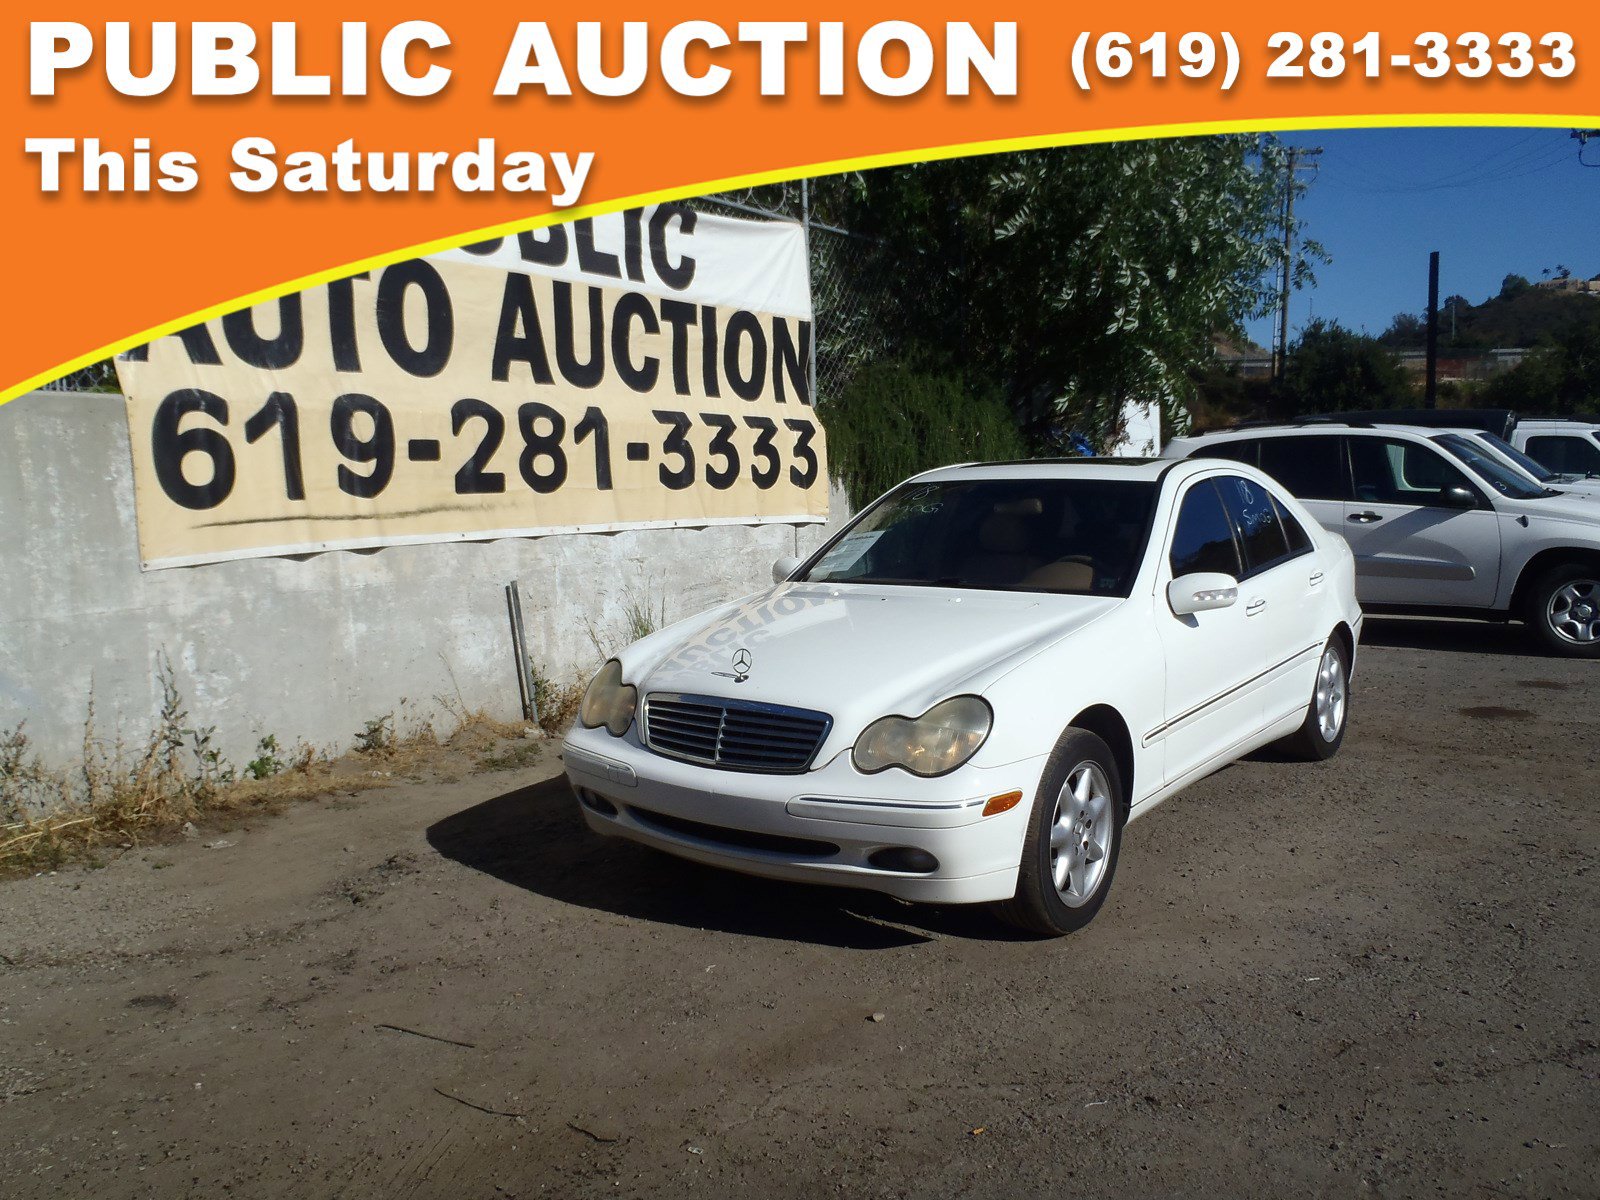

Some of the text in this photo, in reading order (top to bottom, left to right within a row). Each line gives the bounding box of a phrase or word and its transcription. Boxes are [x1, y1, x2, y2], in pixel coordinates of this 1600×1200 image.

[459, 202, 698, 291] BLIC
[491, 271, 811, 407] AUCTION
[152, 388, 819, 510] 619-281-3333
